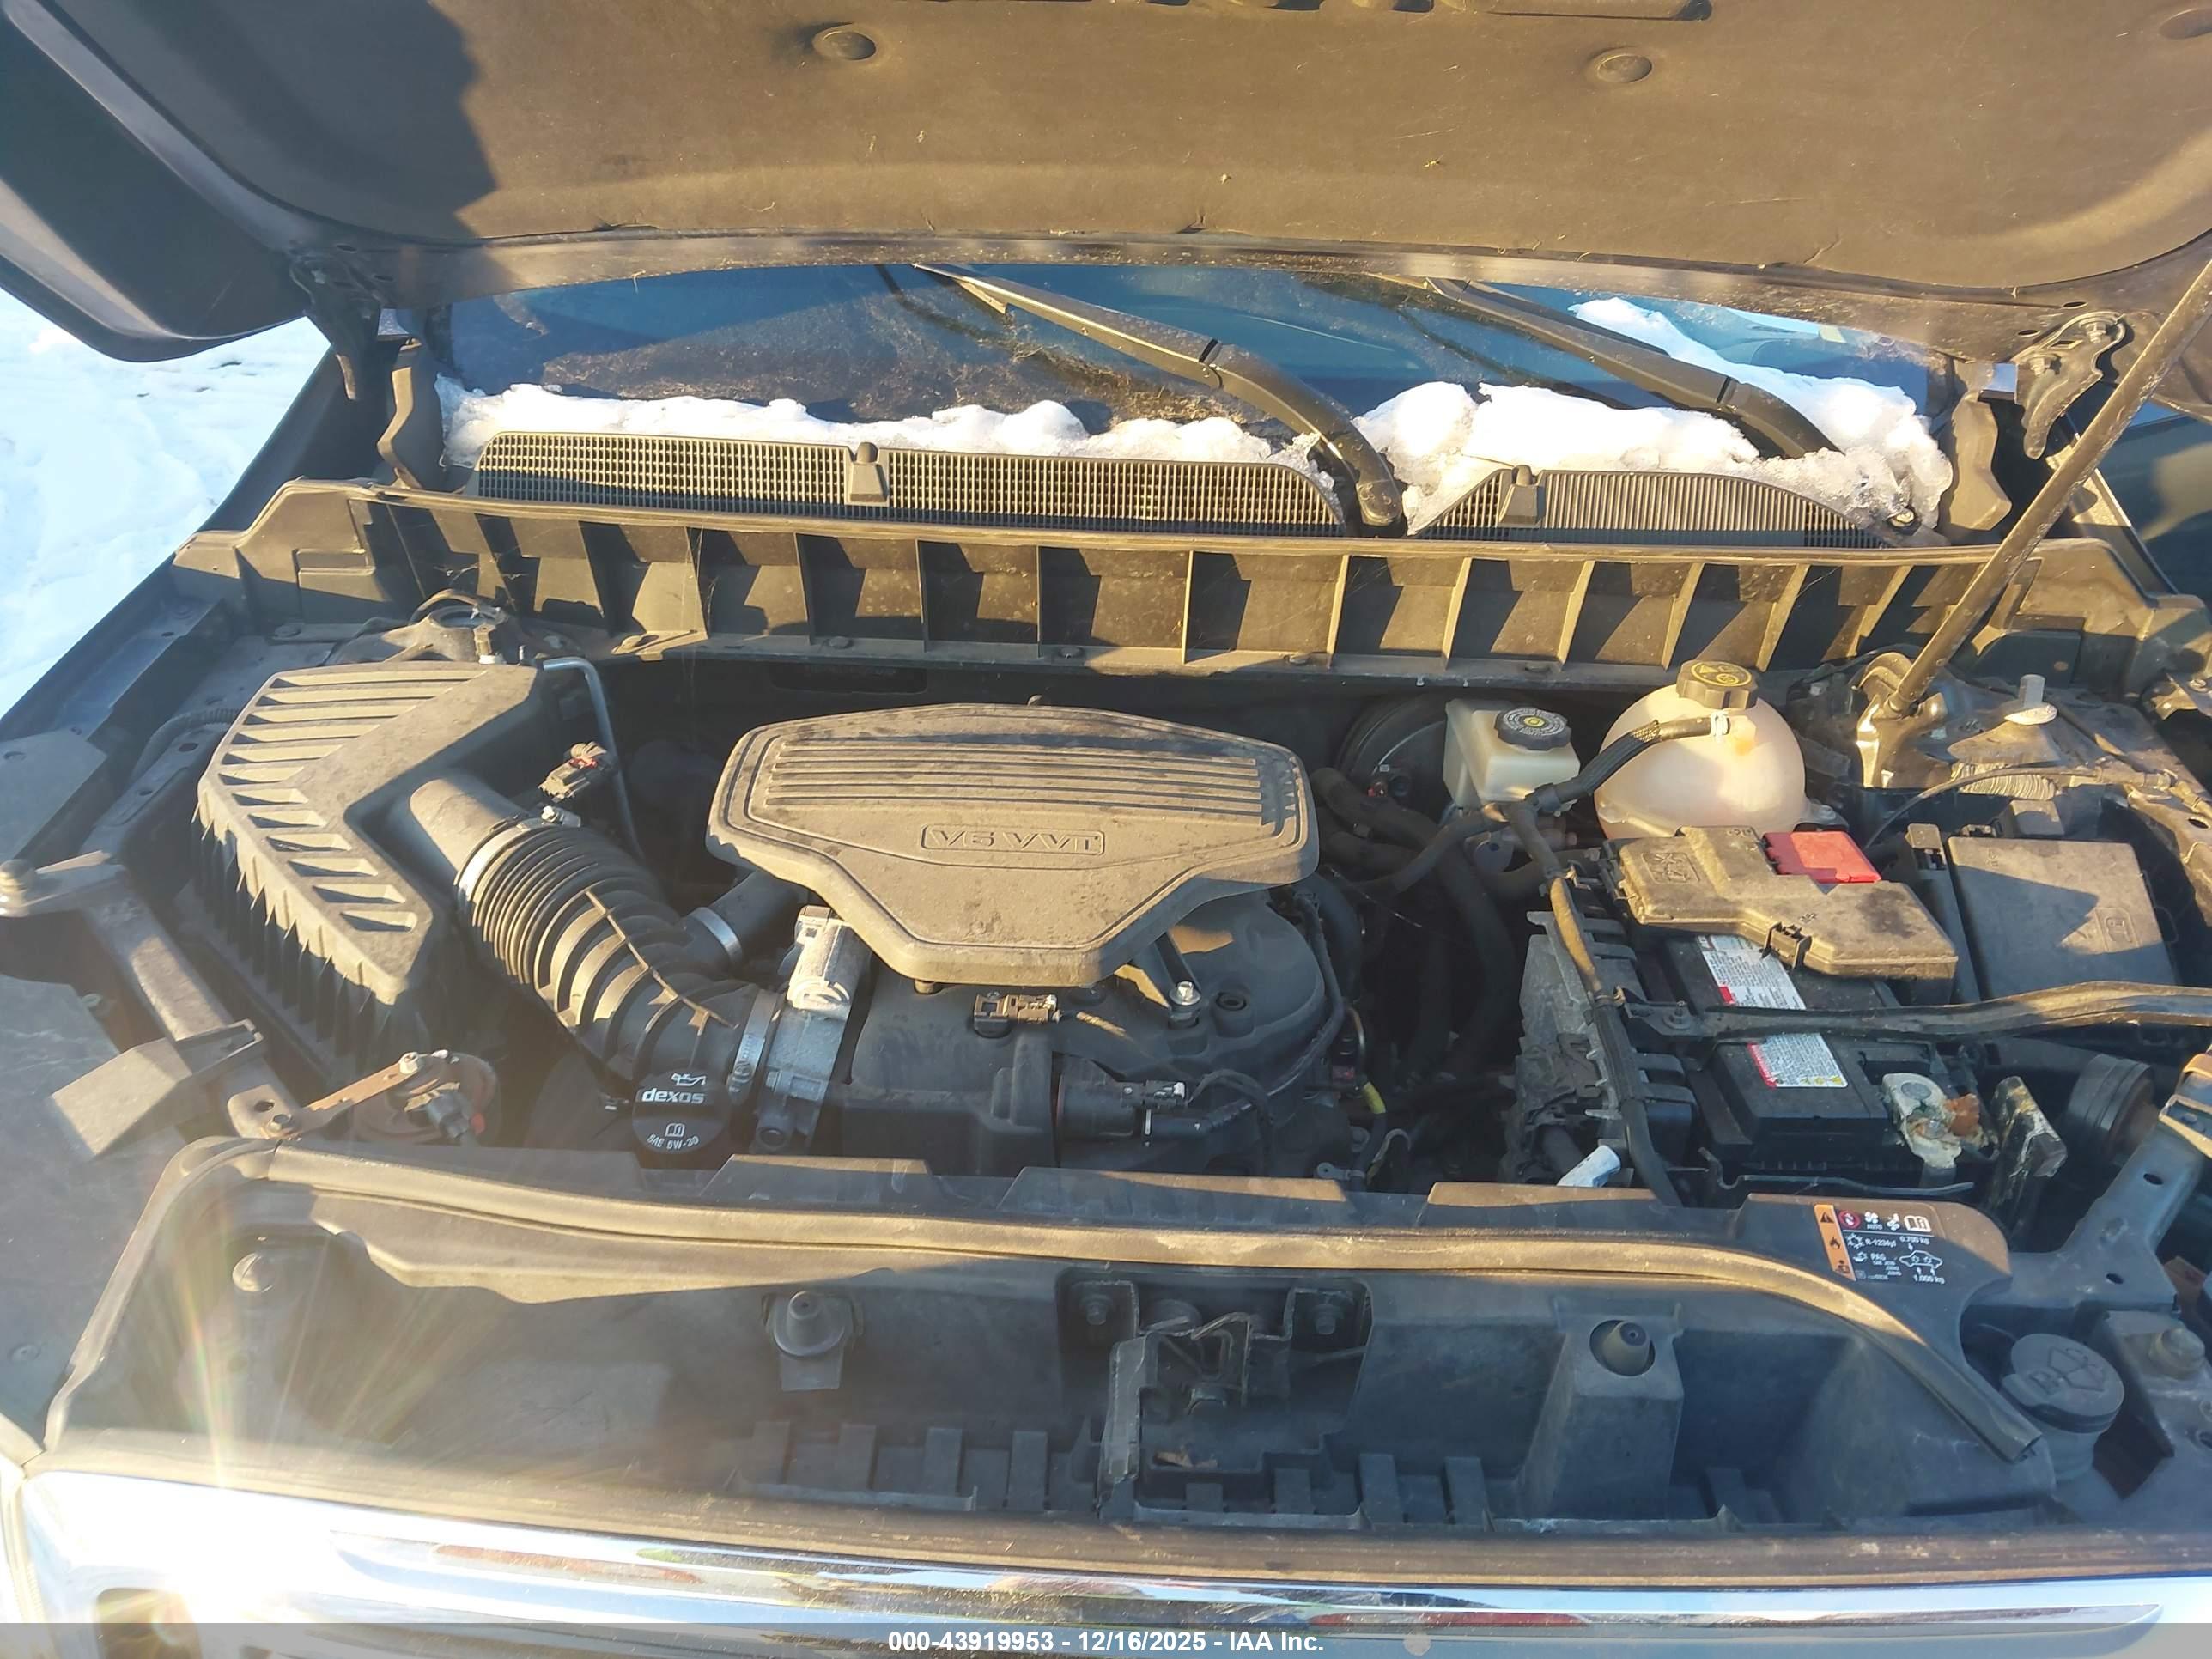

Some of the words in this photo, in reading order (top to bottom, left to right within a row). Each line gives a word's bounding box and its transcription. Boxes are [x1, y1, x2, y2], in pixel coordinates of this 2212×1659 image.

[927, 830, 995, 848] V6
[1002, 831, 1098, 852] VVT
[641, 1088, 704, 1104] dexos
[647, 1133, 665, 1148] SAE
